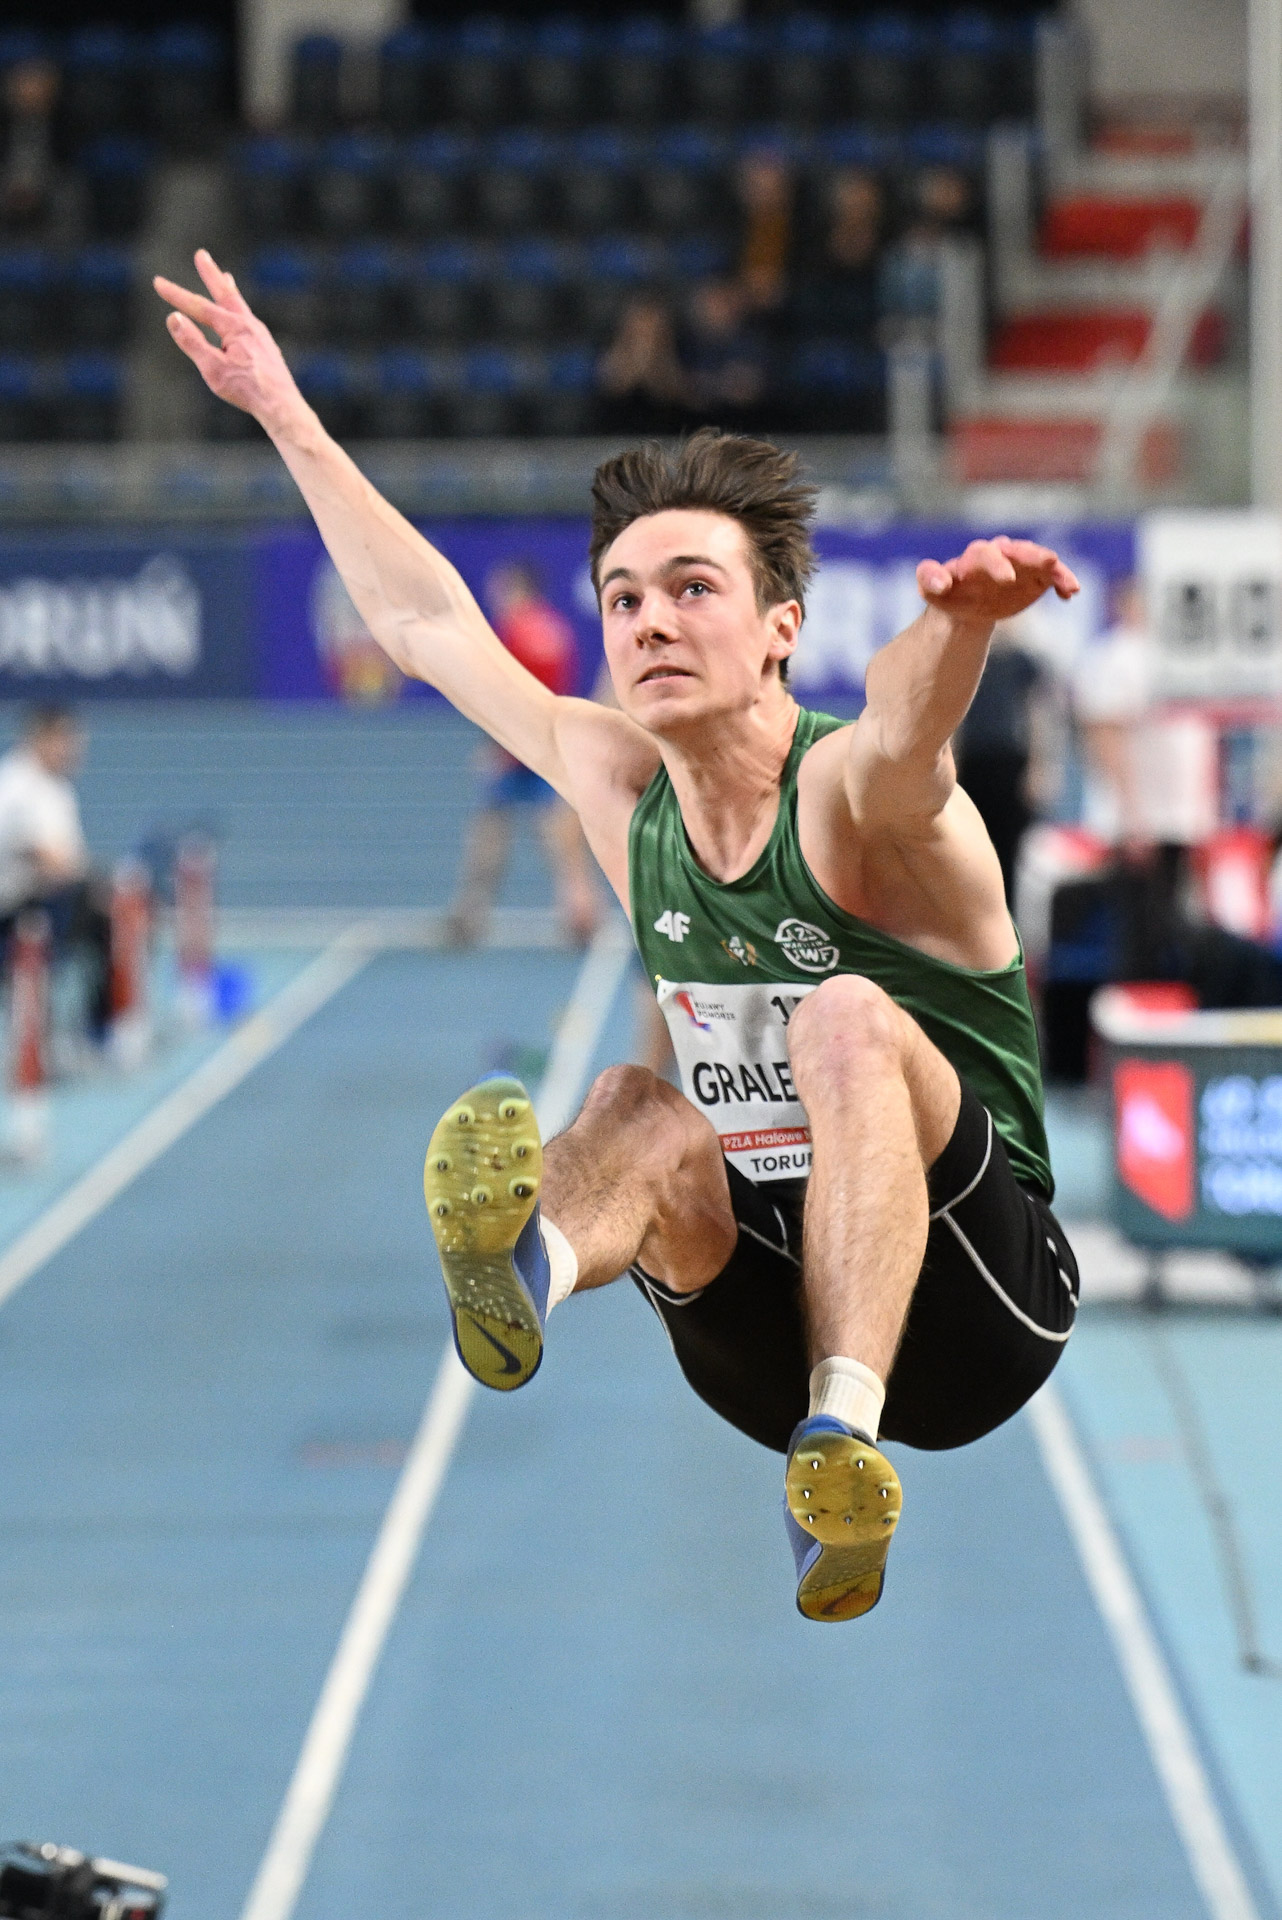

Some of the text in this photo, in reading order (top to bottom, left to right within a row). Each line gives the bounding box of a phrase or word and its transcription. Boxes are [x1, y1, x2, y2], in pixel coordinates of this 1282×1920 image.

[653, 909, 691, 943] 4F
[770, 995, 803, 1026] 1
[692, 1061, 799, 1106] GRALE
[723, 1135, 752, 1149] PZLA
[754, 1131, 803, 1146] Halowe
